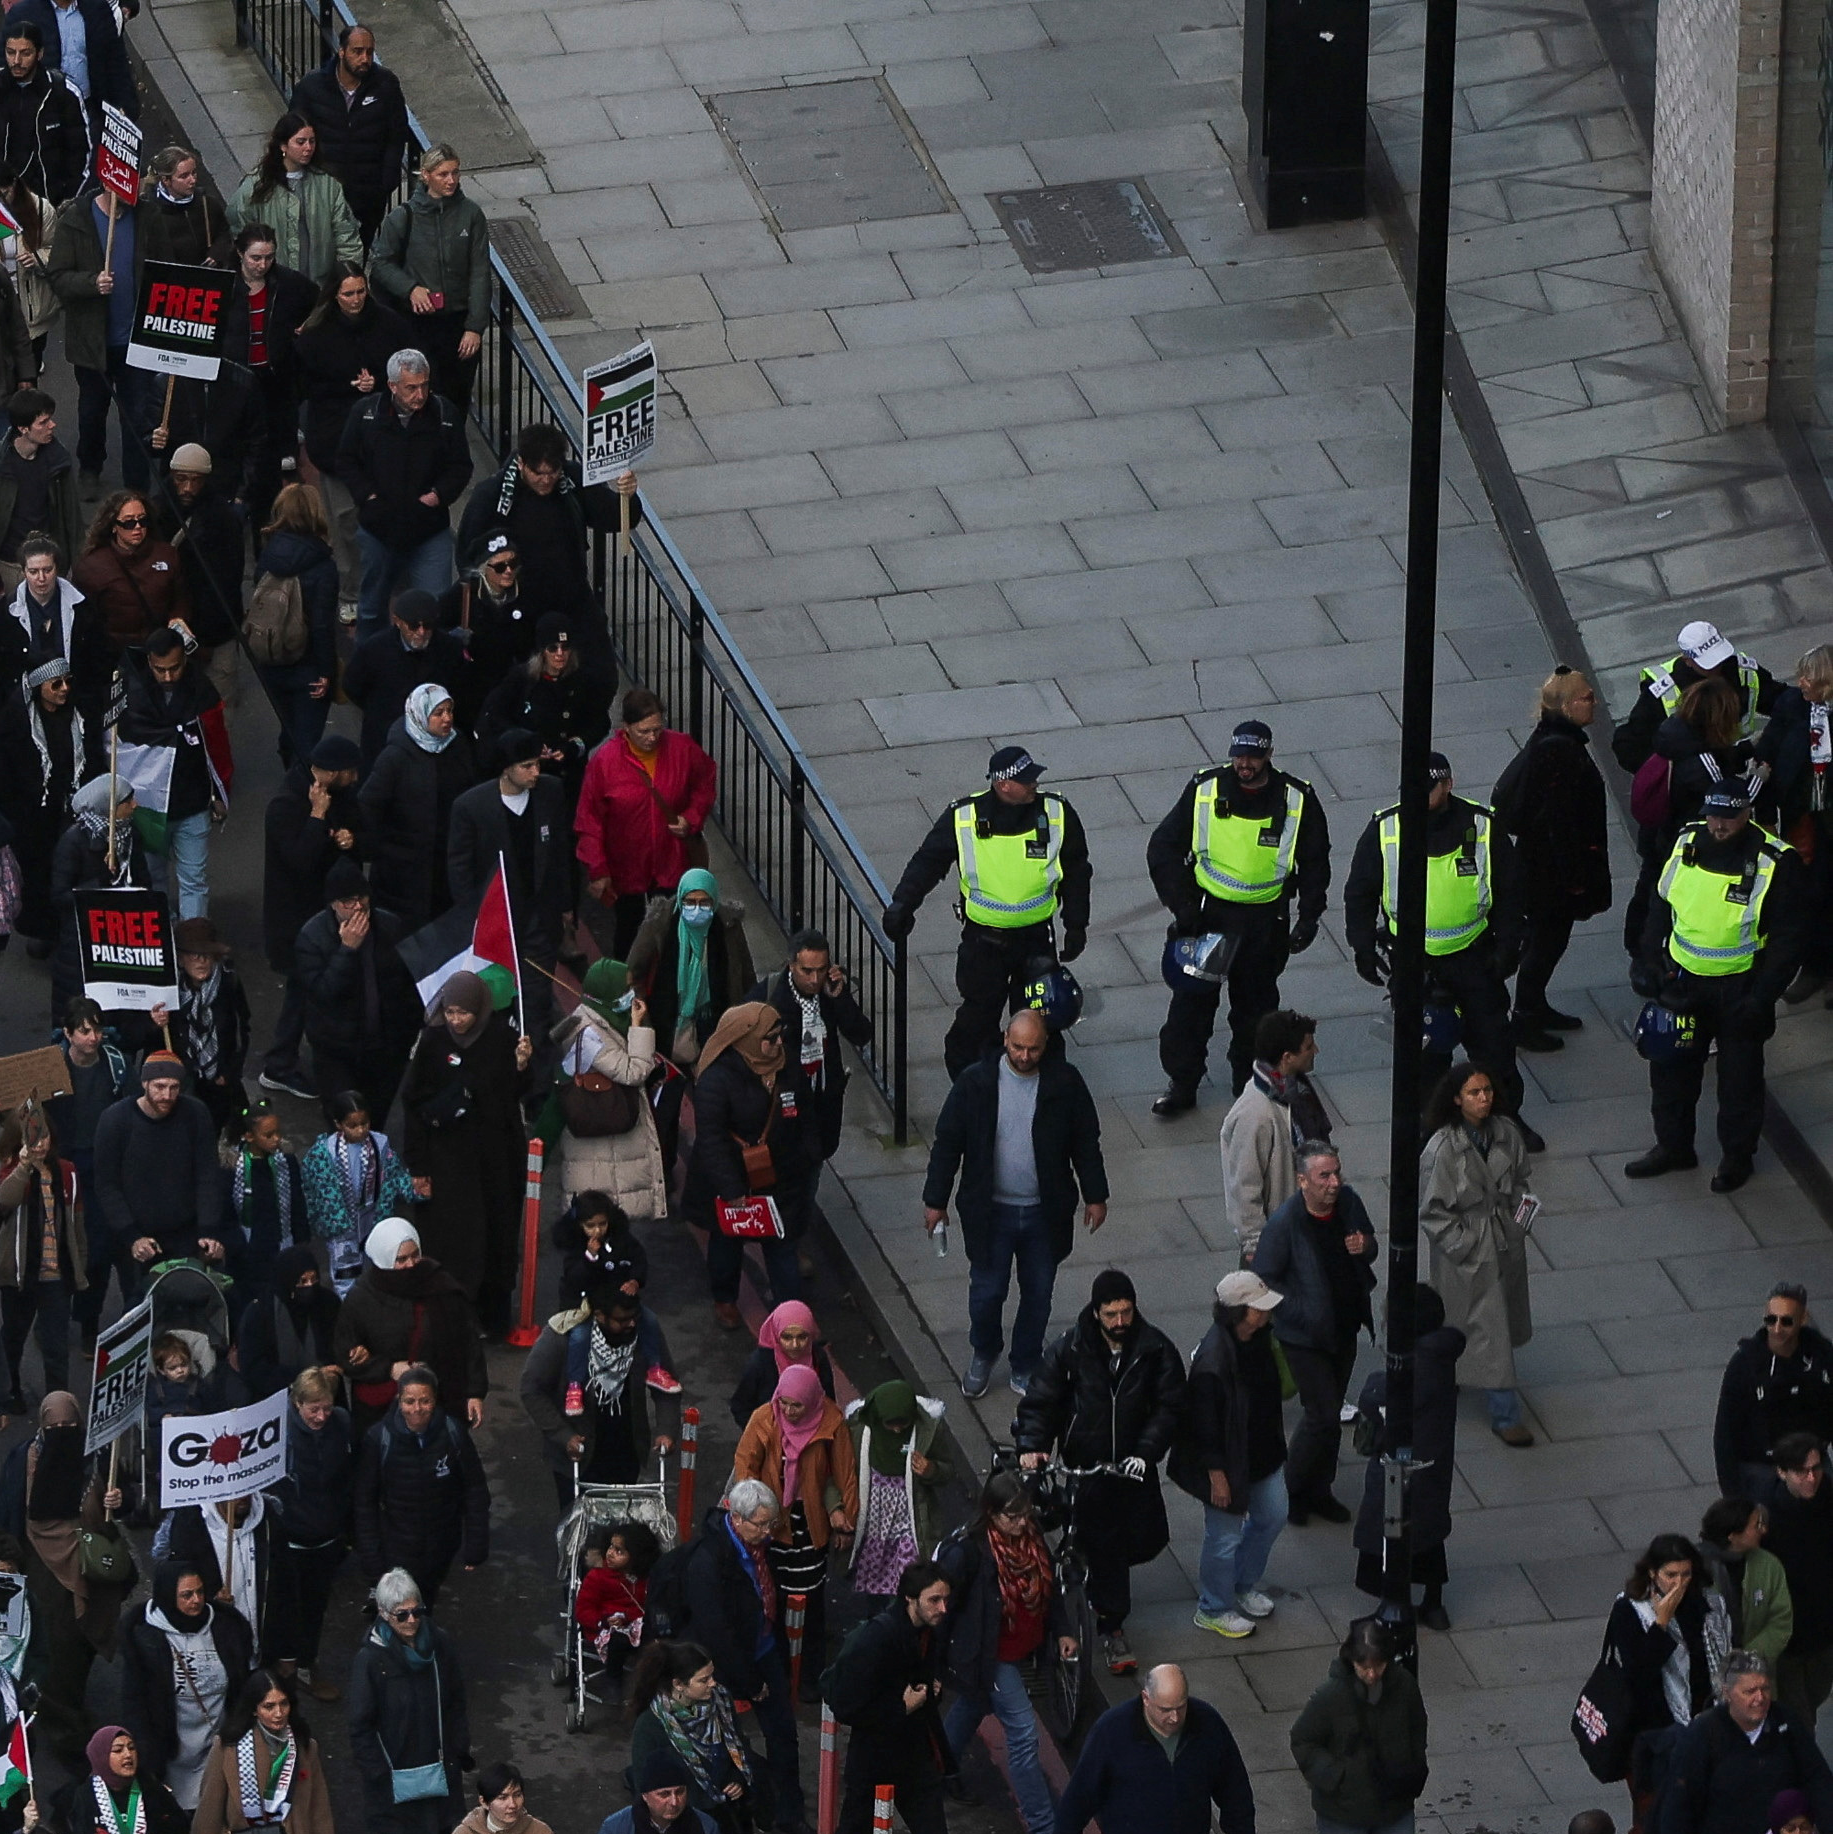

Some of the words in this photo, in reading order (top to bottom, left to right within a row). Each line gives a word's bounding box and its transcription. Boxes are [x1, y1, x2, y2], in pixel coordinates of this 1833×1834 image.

[101, 129, 139, 170] PALESTINE
[104, 114, 139, 151] FREEDOM
[146, 282, 224, 325] FREE
[143, 314, 217, 341] PALESTINE
[586, 393, 655, 448] FREE
[586, 423, 655, 462] PALESTINE
[1698, 636, 1721, 653] POLICE
[88, 909, 163, 947] FREE
[91, 944, 165, 967] PALESTINE
[92, 1353, 147, 1414] FREE
[168, 1416, 282, 1469] Gza
[168, 1478, 200, 1491] Stop
[203, 1473, 224, 1486] the
[227, 1454, 282, 1483] massacre
